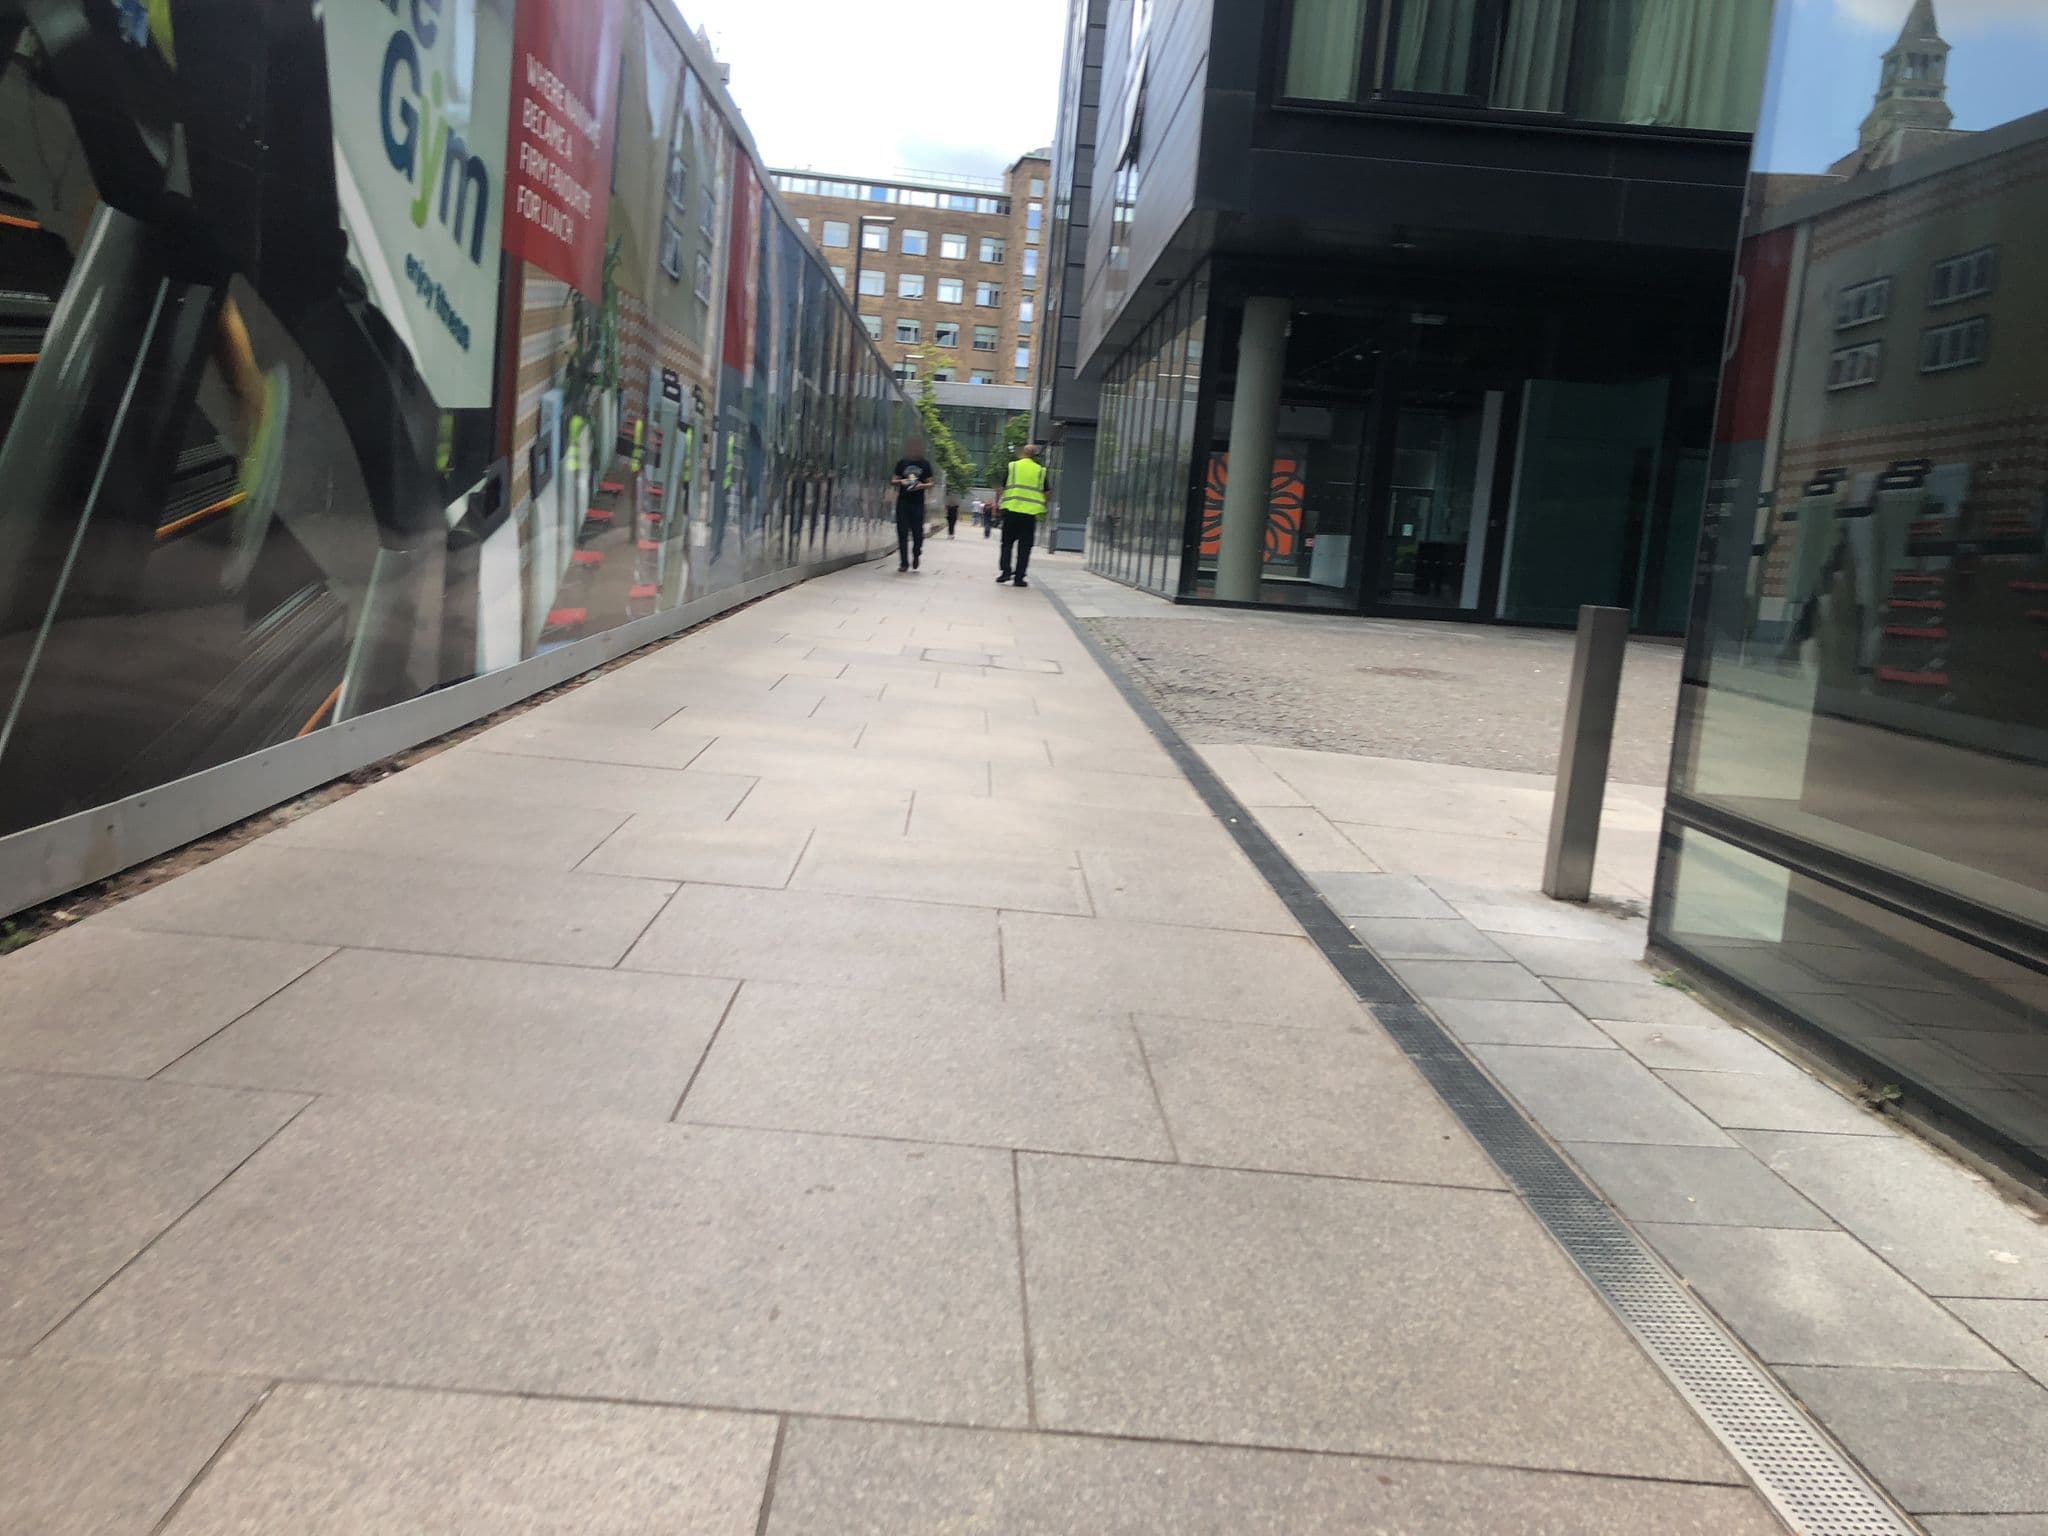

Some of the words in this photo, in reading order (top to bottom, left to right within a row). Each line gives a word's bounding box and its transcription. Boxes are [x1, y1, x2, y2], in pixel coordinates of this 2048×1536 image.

[526, 53, 565, 112] WHERE
[380, 29, 489, 266] Gym
[522, 97, 566, 156] BECAME
[520, 141, 548, 185] FIRM
[517, 185, 541, 224] FOR
[541, 199, 574, 245] LUNCH
